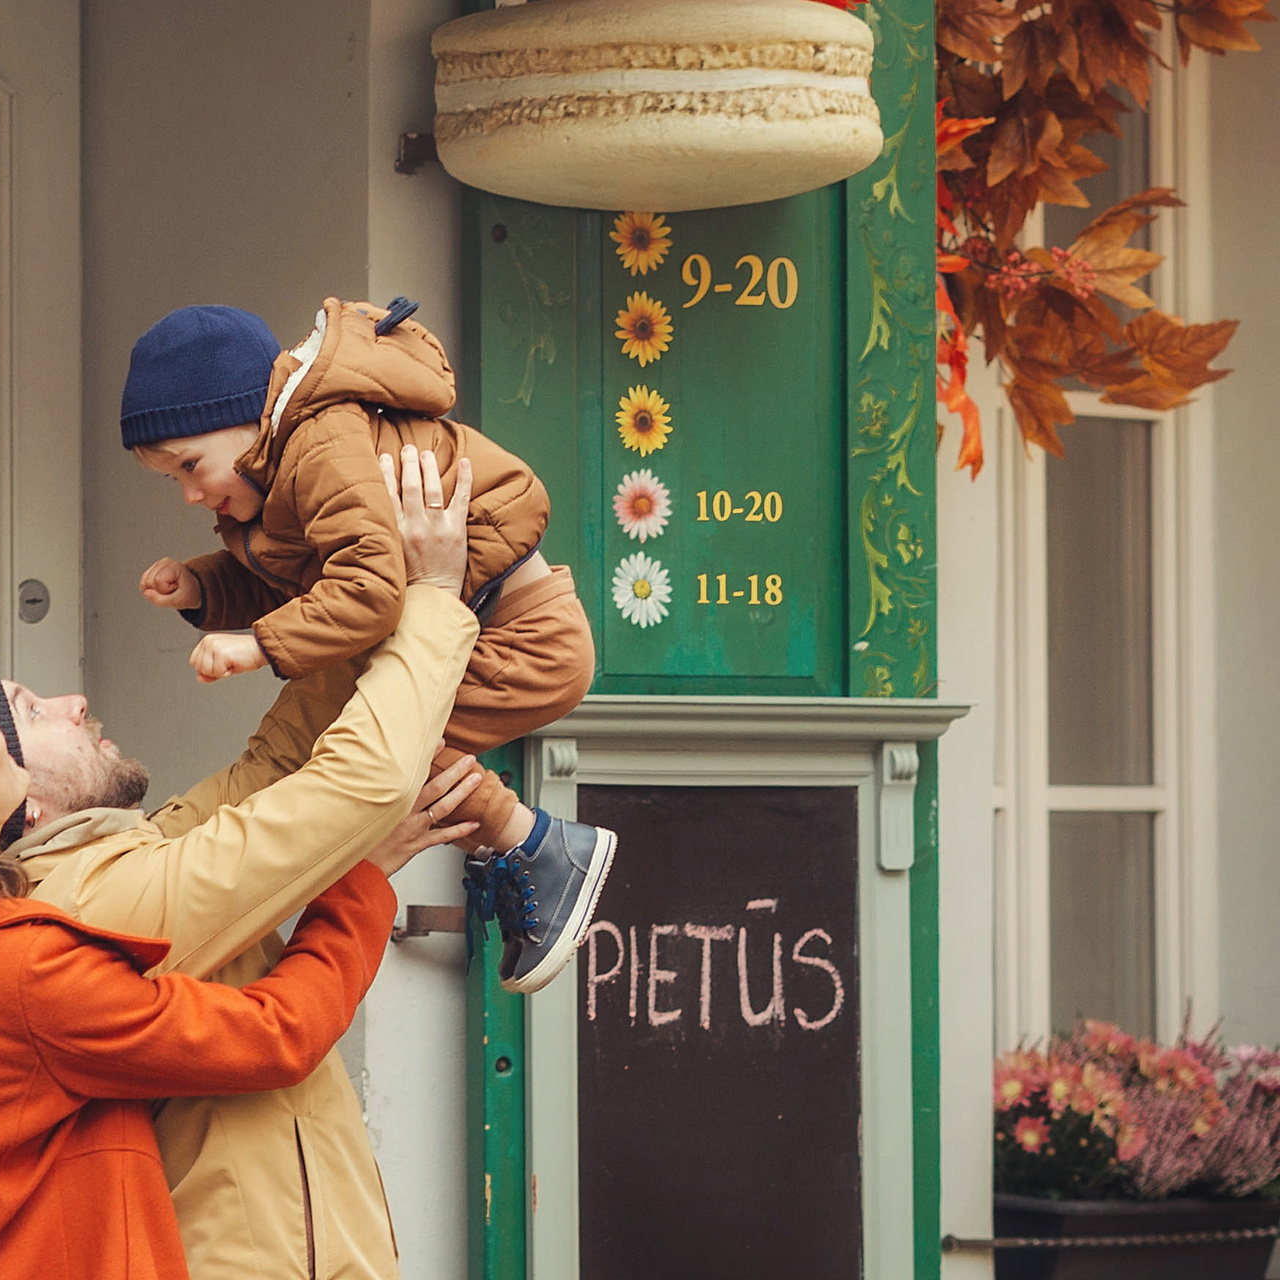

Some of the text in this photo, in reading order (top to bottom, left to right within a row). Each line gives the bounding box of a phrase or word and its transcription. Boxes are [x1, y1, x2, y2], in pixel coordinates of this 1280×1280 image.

[681, 253, 799, 310] 9-20
[696, 490, 783, 523] 10-20
[696, 573, 783, 606] 11-18
[580, 898, 845, 1031] PIETŪS
